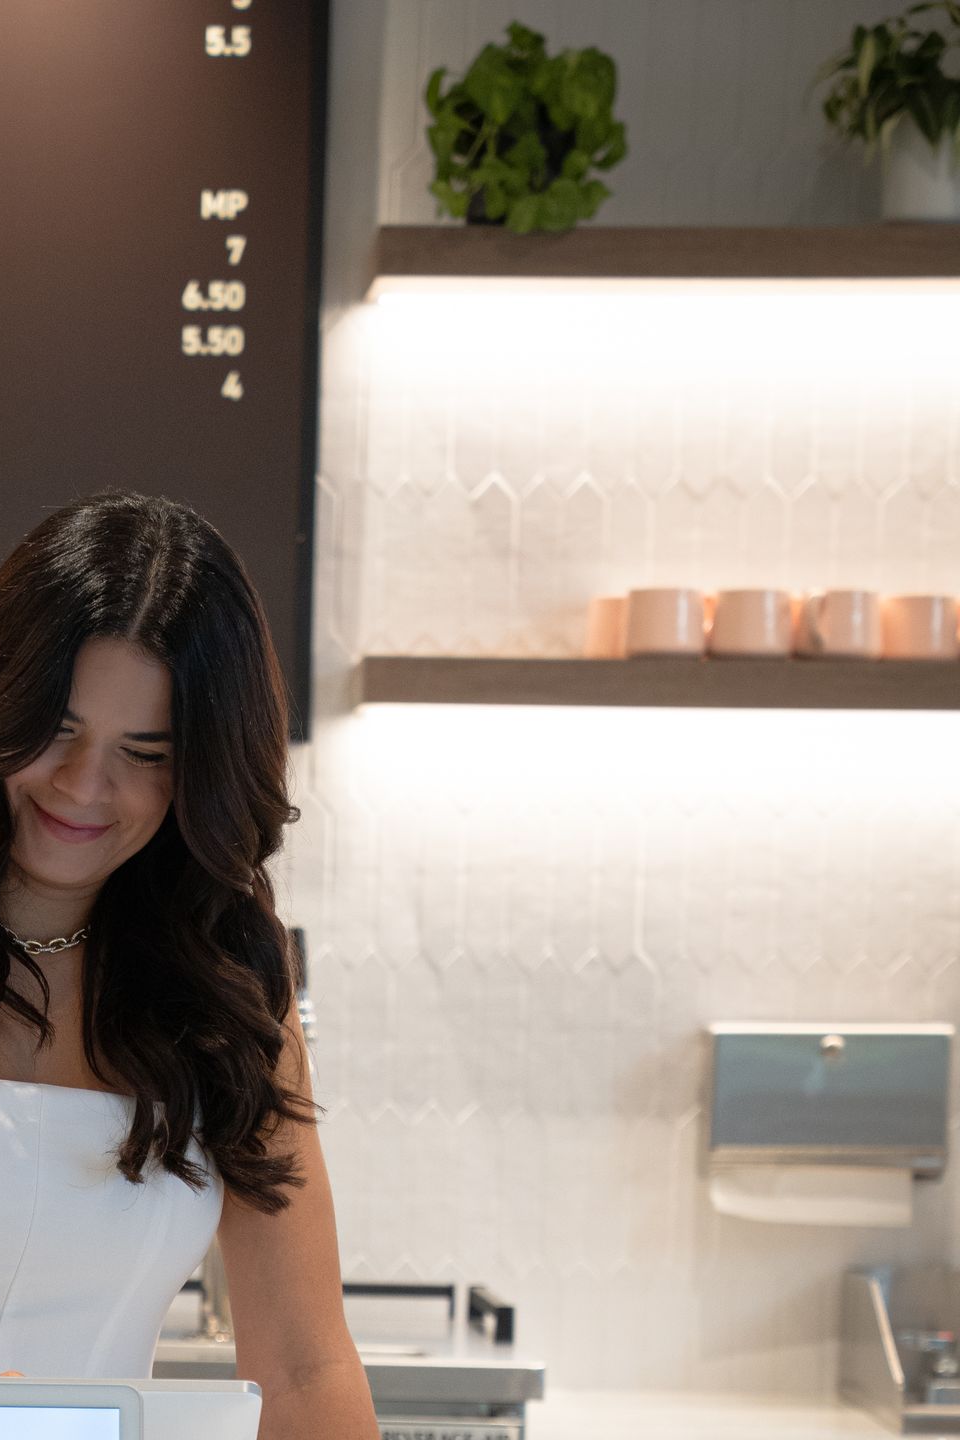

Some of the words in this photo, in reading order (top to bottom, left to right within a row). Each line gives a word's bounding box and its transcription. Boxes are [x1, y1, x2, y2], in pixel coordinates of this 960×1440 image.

[205, 25, 251, 57] 5.5
[200, 189, 249, 219] MP
[225, 235, 247, 266] 7
[181, 280, 246, 311] 6.50
[181, 325, 245, 356] 5.50
[221, 371, 243, 400] 4
